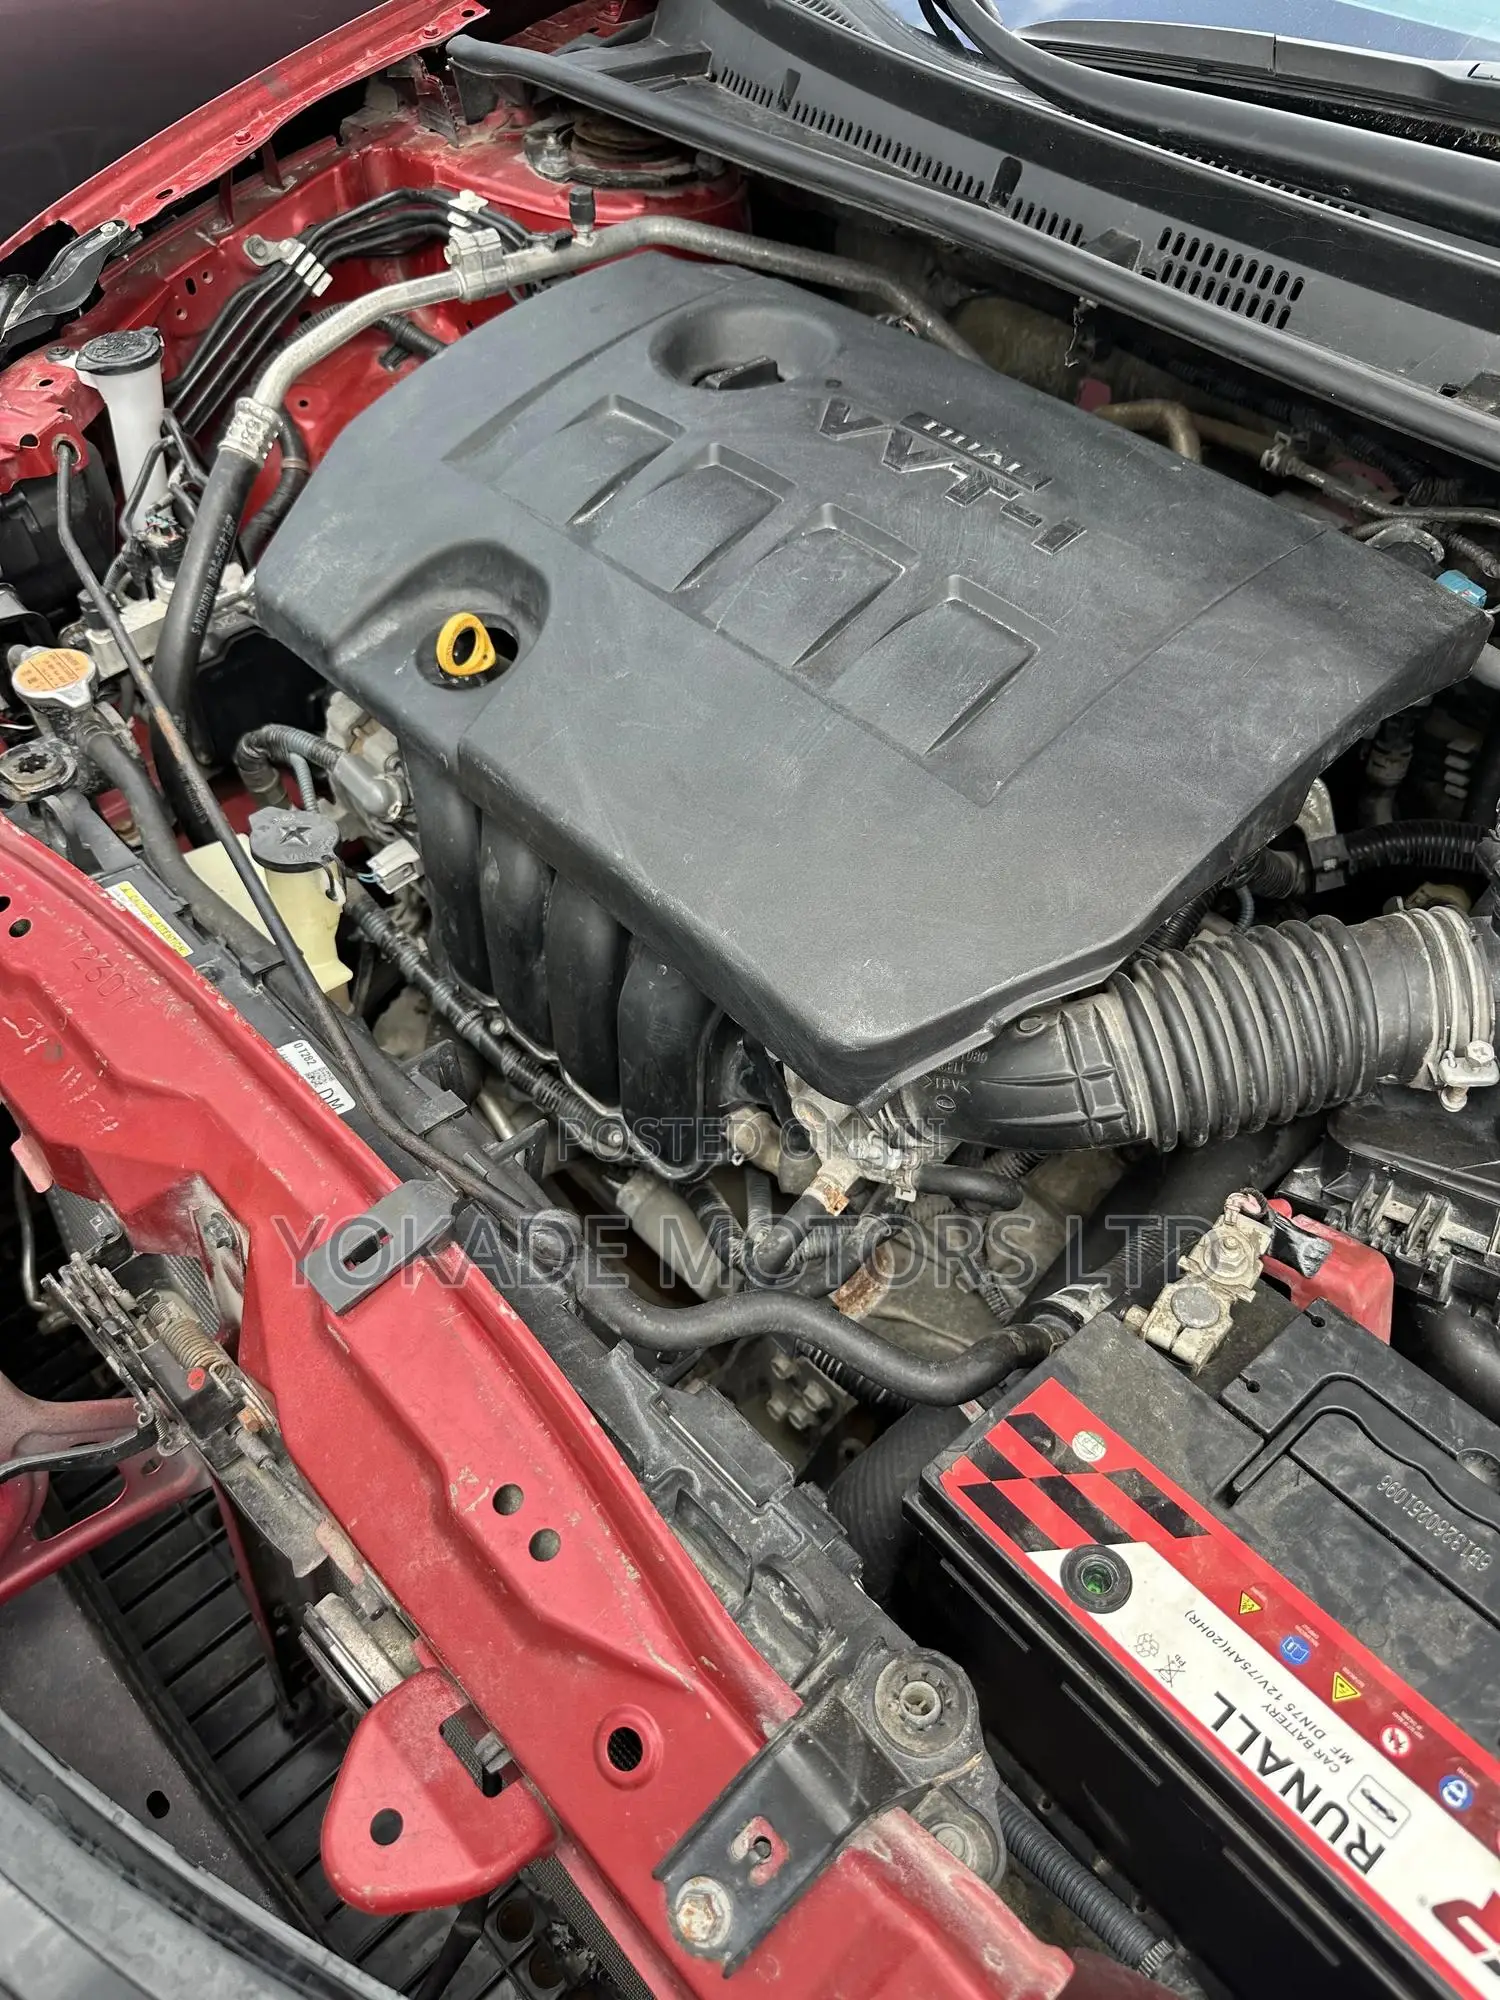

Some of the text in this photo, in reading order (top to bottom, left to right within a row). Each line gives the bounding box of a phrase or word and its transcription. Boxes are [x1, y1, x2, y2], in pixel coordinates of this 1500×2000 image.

[1261, 1703, 1340, 1773] CAR BATTERY
[1284, 1703, 1327, 1740] DIN75
[1329, 1746, 1354, 1765] MF
[1211, 1691, 1385, 1874] RUNALL
